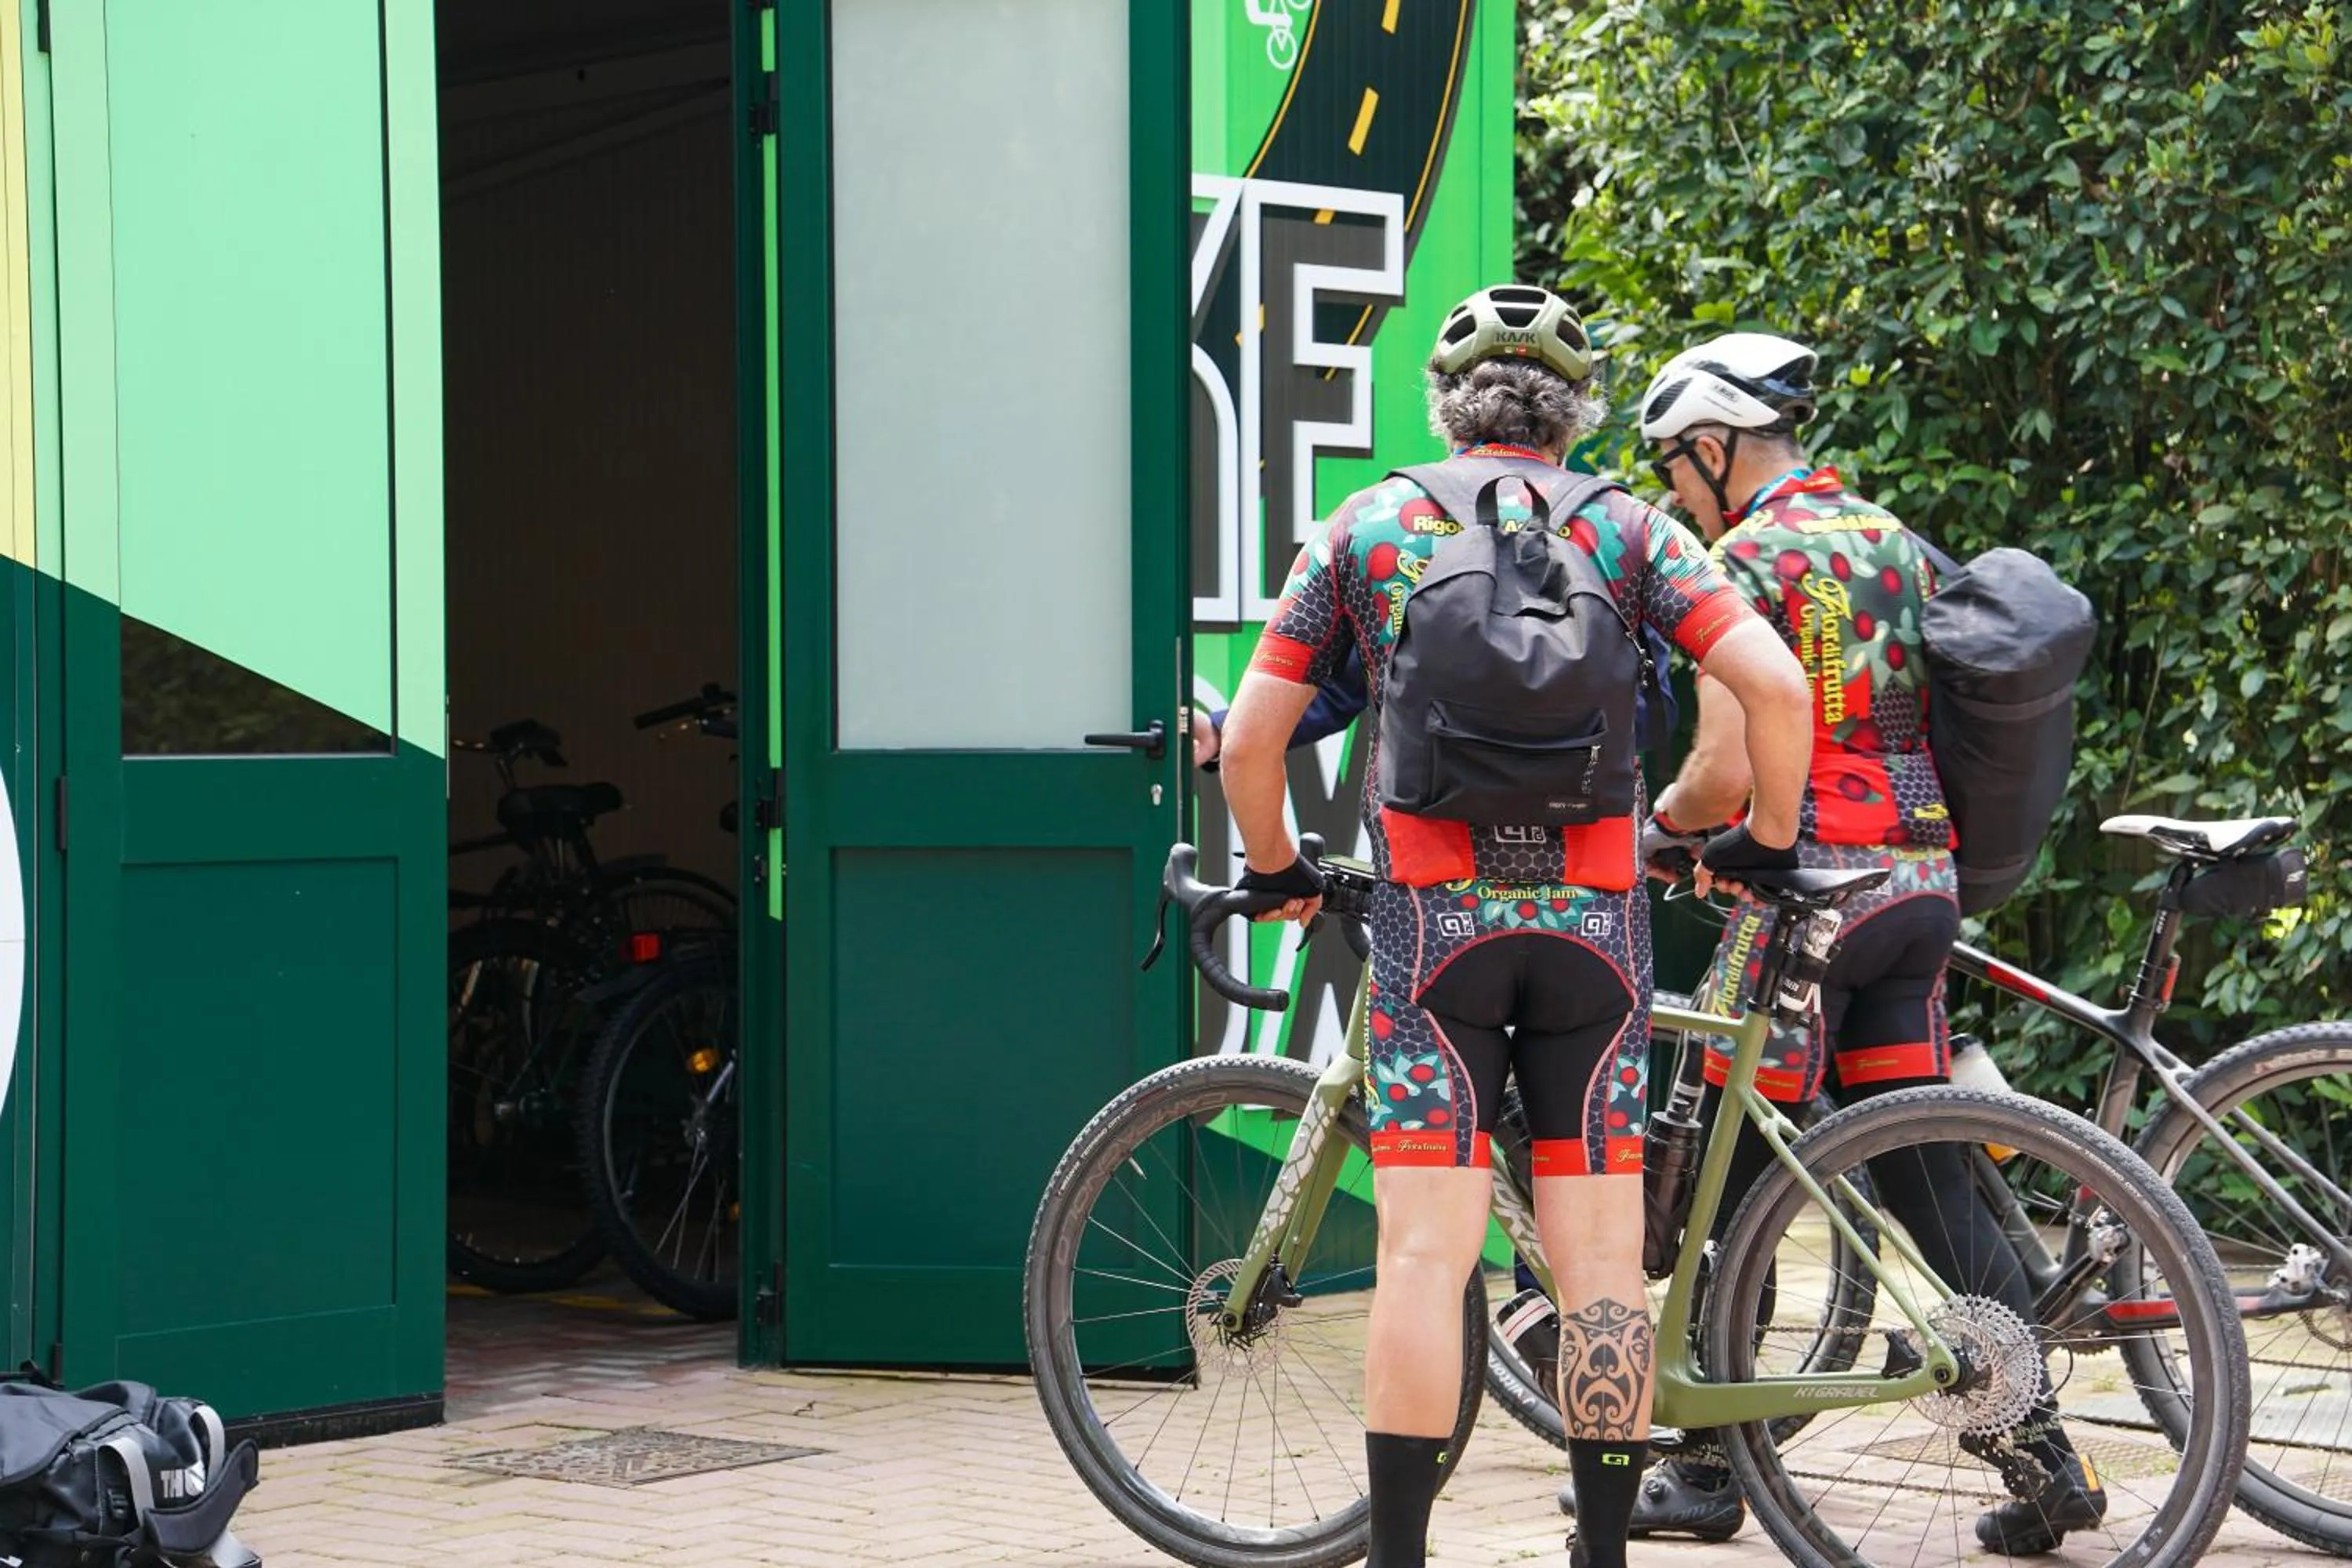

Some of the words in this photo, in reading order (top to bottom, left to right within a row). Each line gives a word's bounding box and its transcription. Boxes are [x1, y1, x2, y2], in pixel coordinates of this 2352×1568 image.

[1801, 578, 1854, 726] Fiordifrutta
[1476, 885, 1541, 902] Organic
[1544, 887, 1577, 900] Jam
